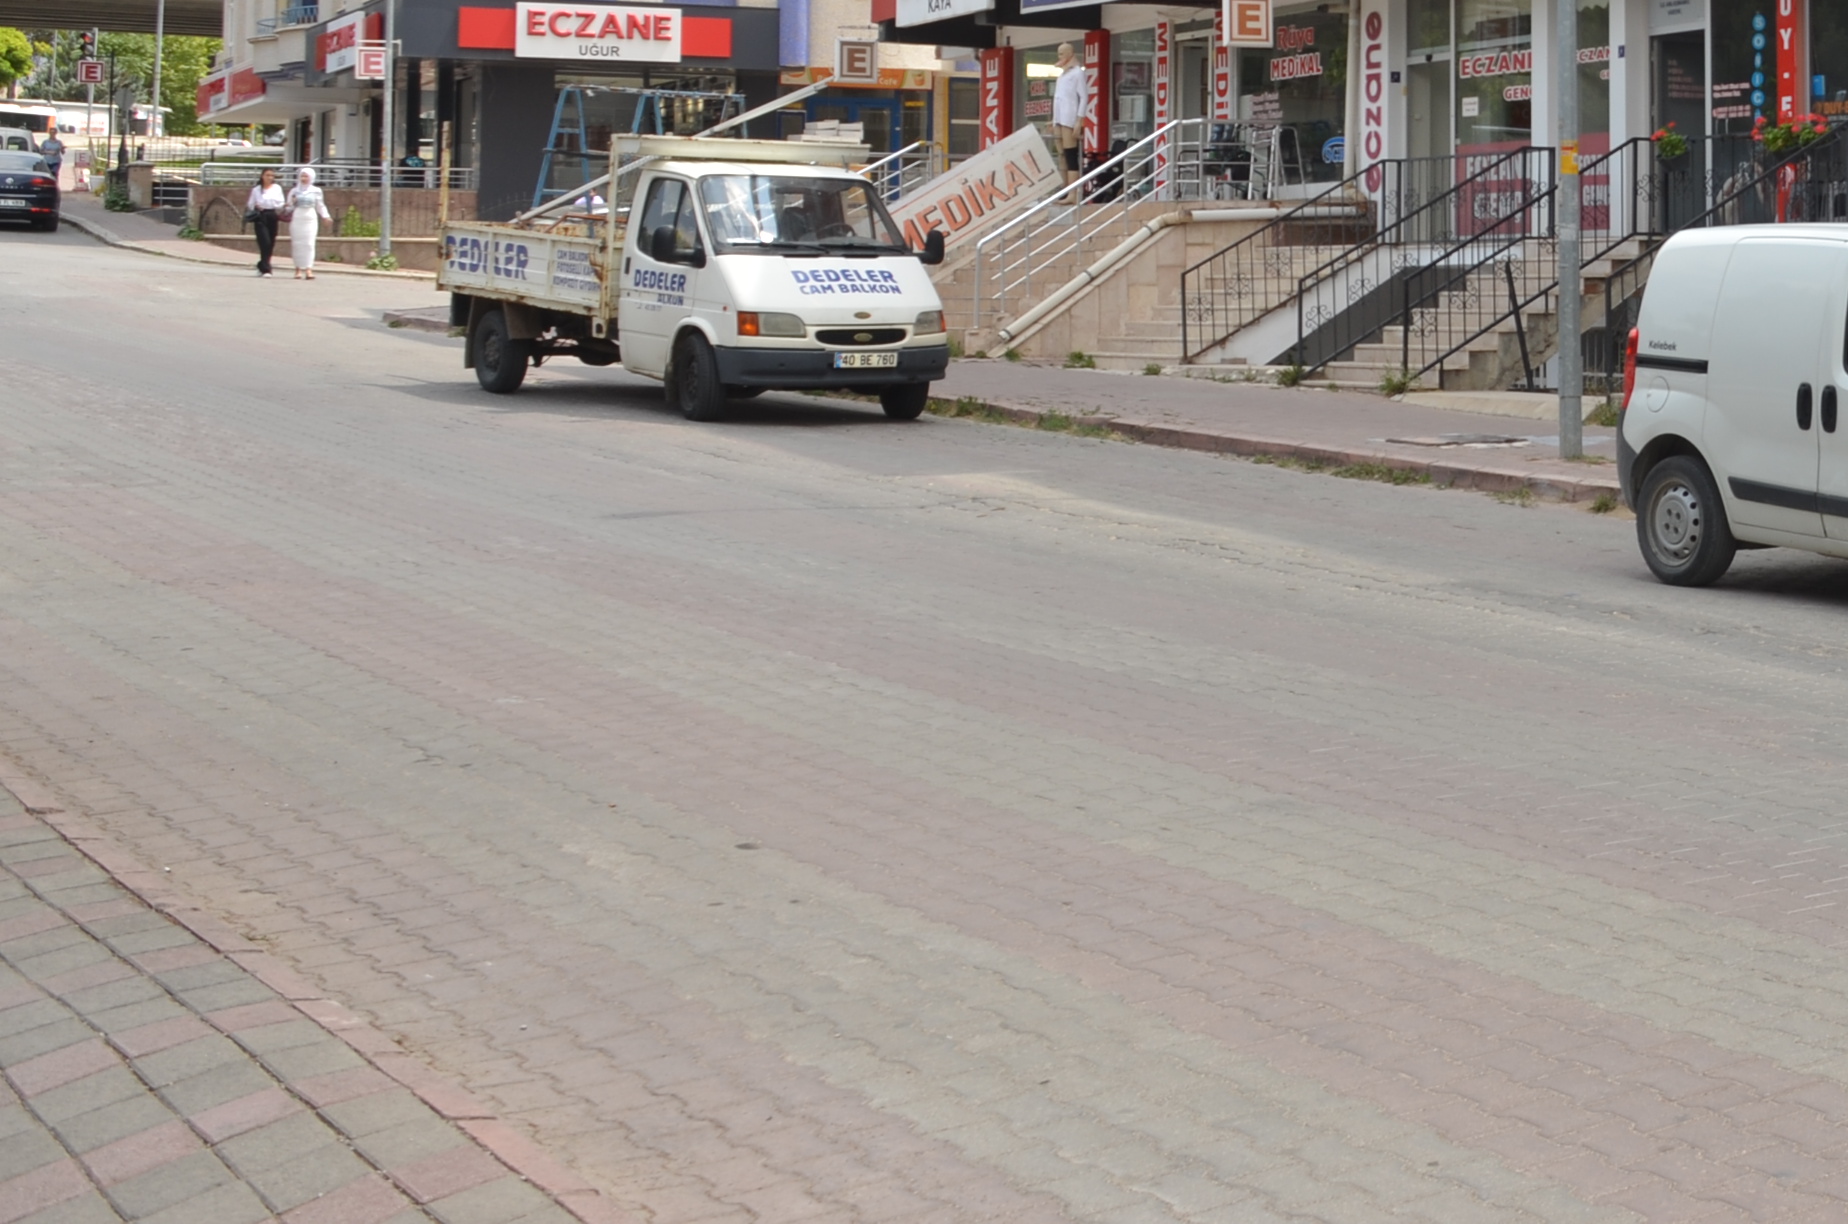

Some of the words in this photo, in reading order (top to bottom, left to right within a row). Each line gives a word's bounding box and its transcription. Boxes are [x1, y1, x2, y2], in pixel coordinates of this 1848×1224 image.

[527, 8, 673, 41] ECZANE
[1237, 4, 1262, 36] E
[1277, 25, 1315, 52] Rüya
[578, 43, 620, 57] UĞUR
[363, 53, 383, 74] E
[847, 47, 867, 73] E
[85, 65, 98, 75] E
[1365, 11, 1382, 194] eczane
[1504, 86, 1531, 102] GEN
[633, 268, 687, 293] DEDELER
[791, 269, 898, 284] DEDELER
[799, 284, 835, 295] CAM
[840, 283, 902, 295] BALKON
[1648, 340, 1677, 351] Kelebek
[841, 353, 855, 366] 40
[860, 353, 872, 366] BE
[876, 353, 895, 366] 760
